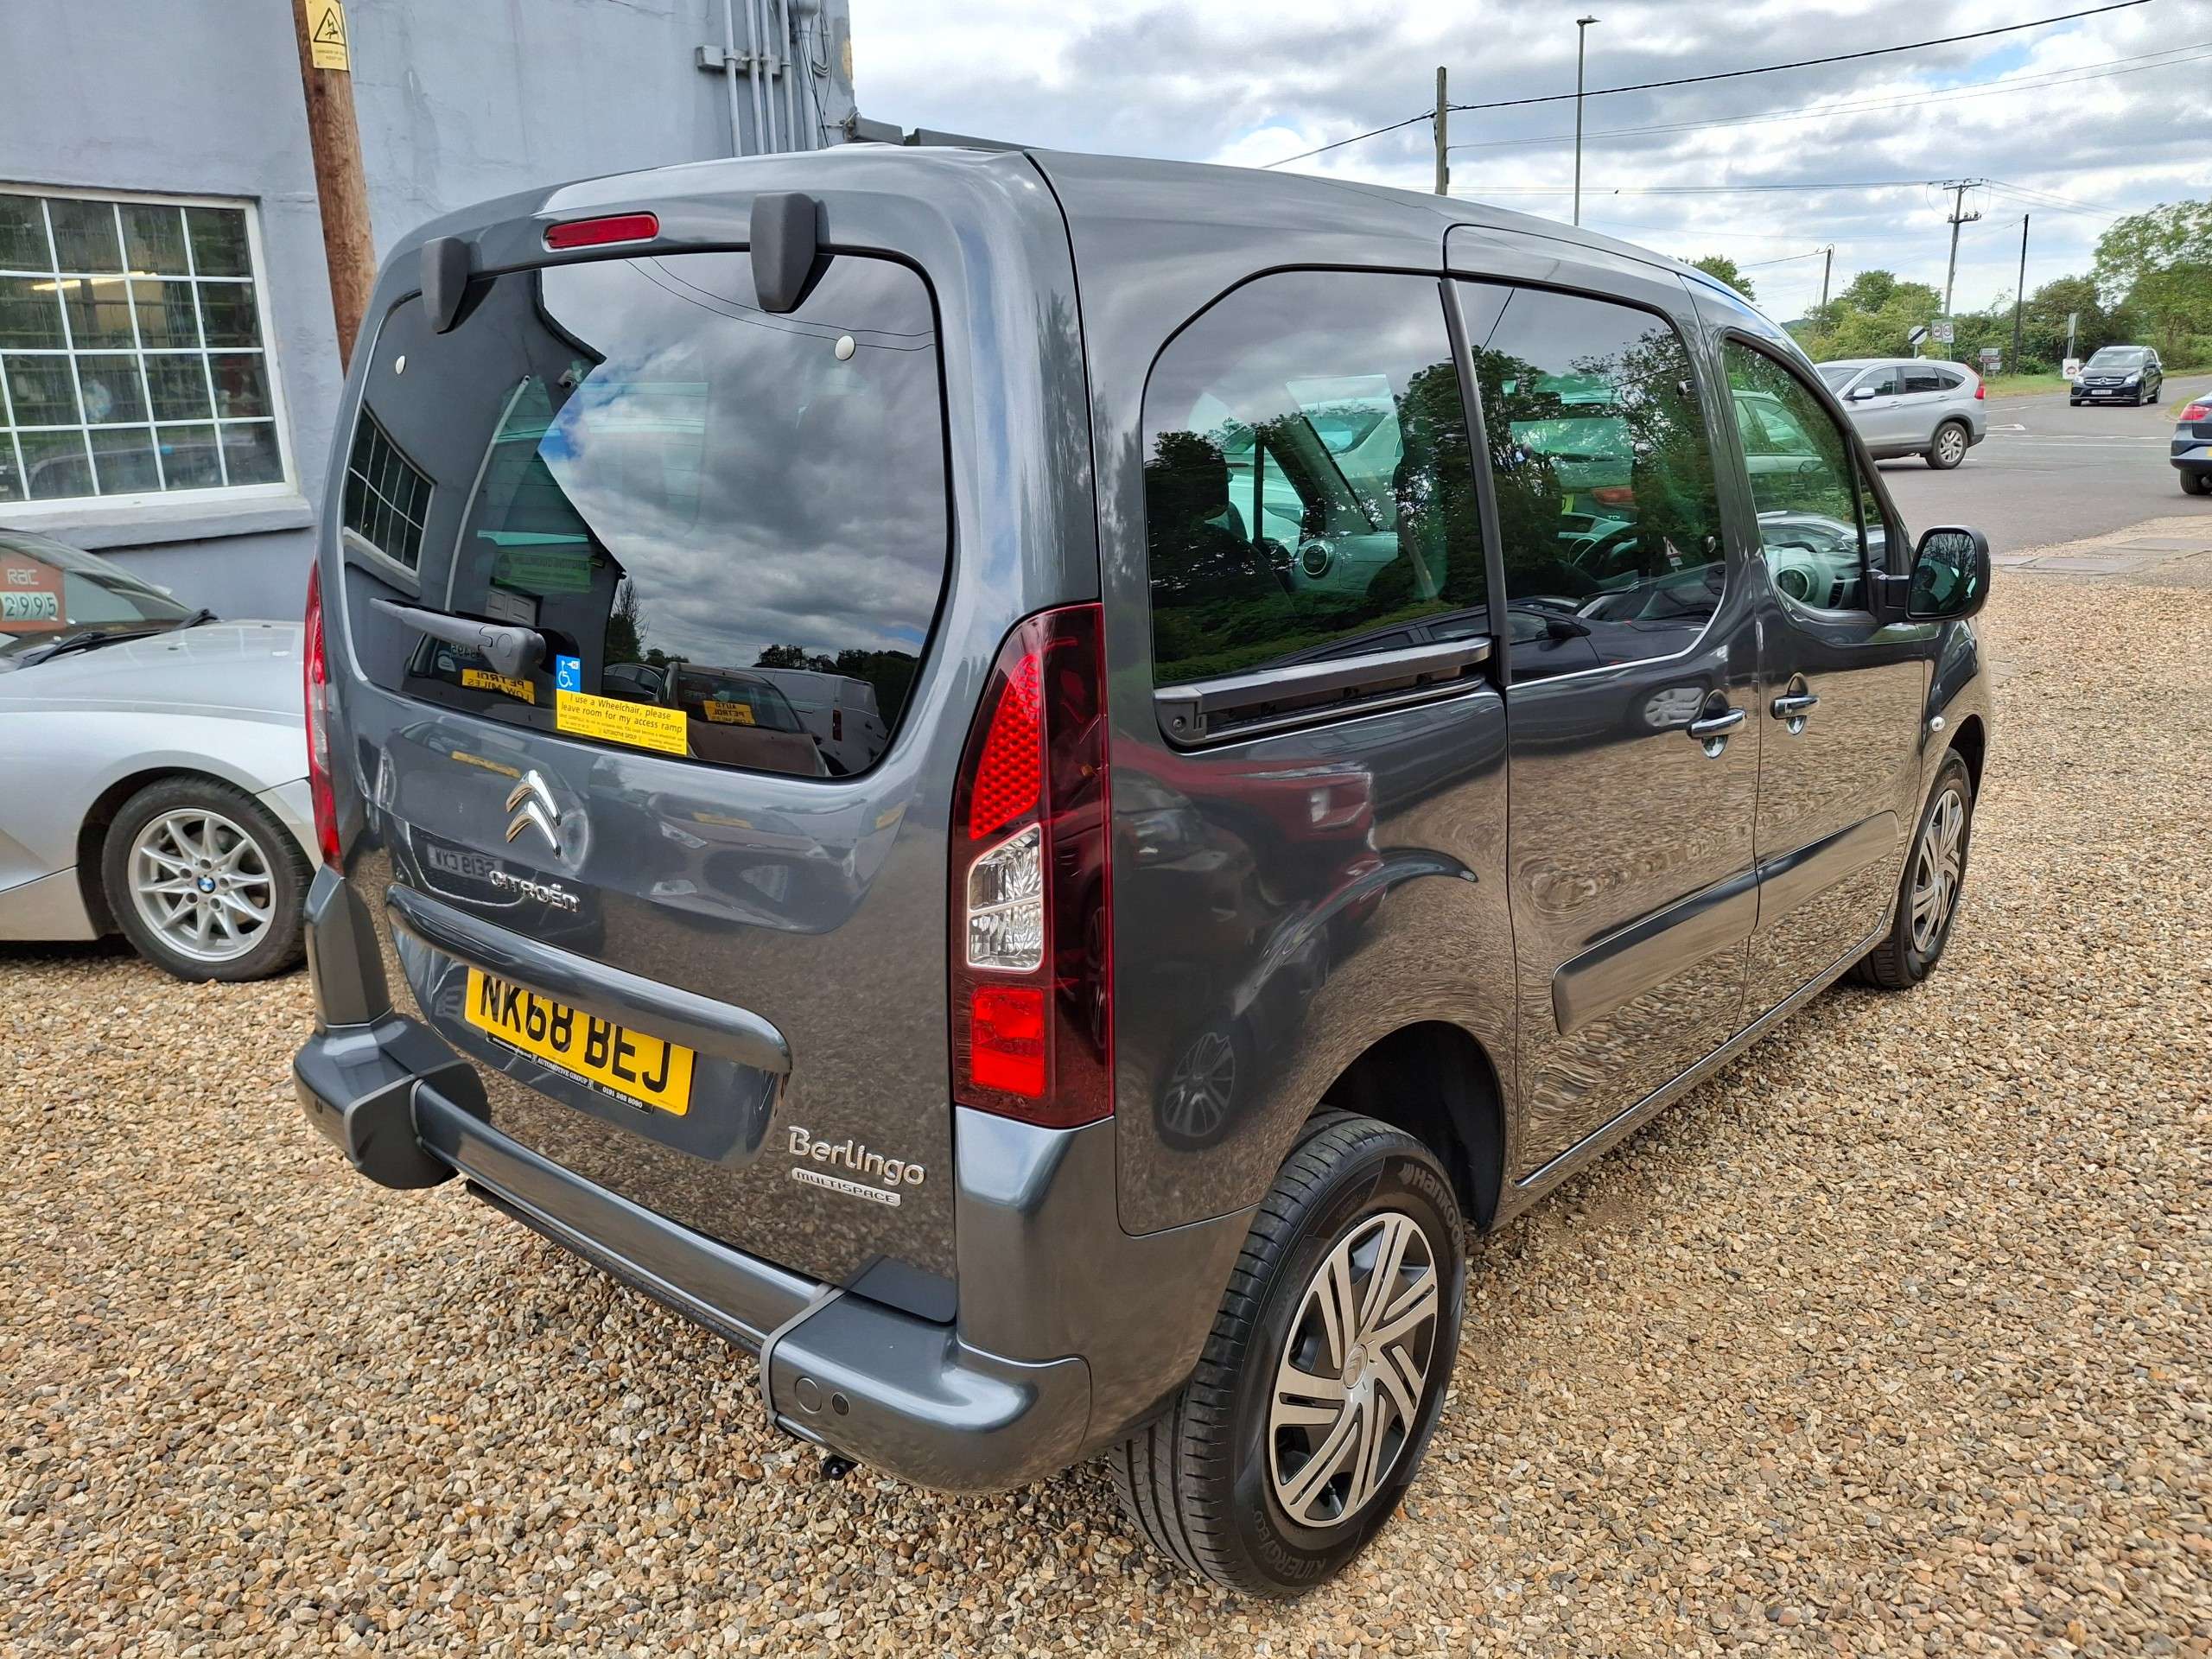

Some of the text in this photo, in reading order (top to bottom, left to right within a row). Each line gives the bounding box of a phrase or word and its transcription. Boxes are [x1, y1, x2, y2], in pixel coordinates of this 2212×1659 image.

[5, 595, 57, 617] 2995
[561, 702, 581, 714] leave
[582, 709, 602, 718] room
[605, 710, 616, 720] for
[619, 715, 631, 725] my
[634, 717, 658, 729] access
[661, 722, 683, 734] ramp
[575, 696, 588, 704] use
[598, 699, 642, 716] Wheelchair,
[645, 709, 671, 721] please
[480, 973, 671, 1094] NK68 BEJ
[788, 1125, 925, 1186] Berlingo
[797, 1171, 895, 1204] MULTISPACE
